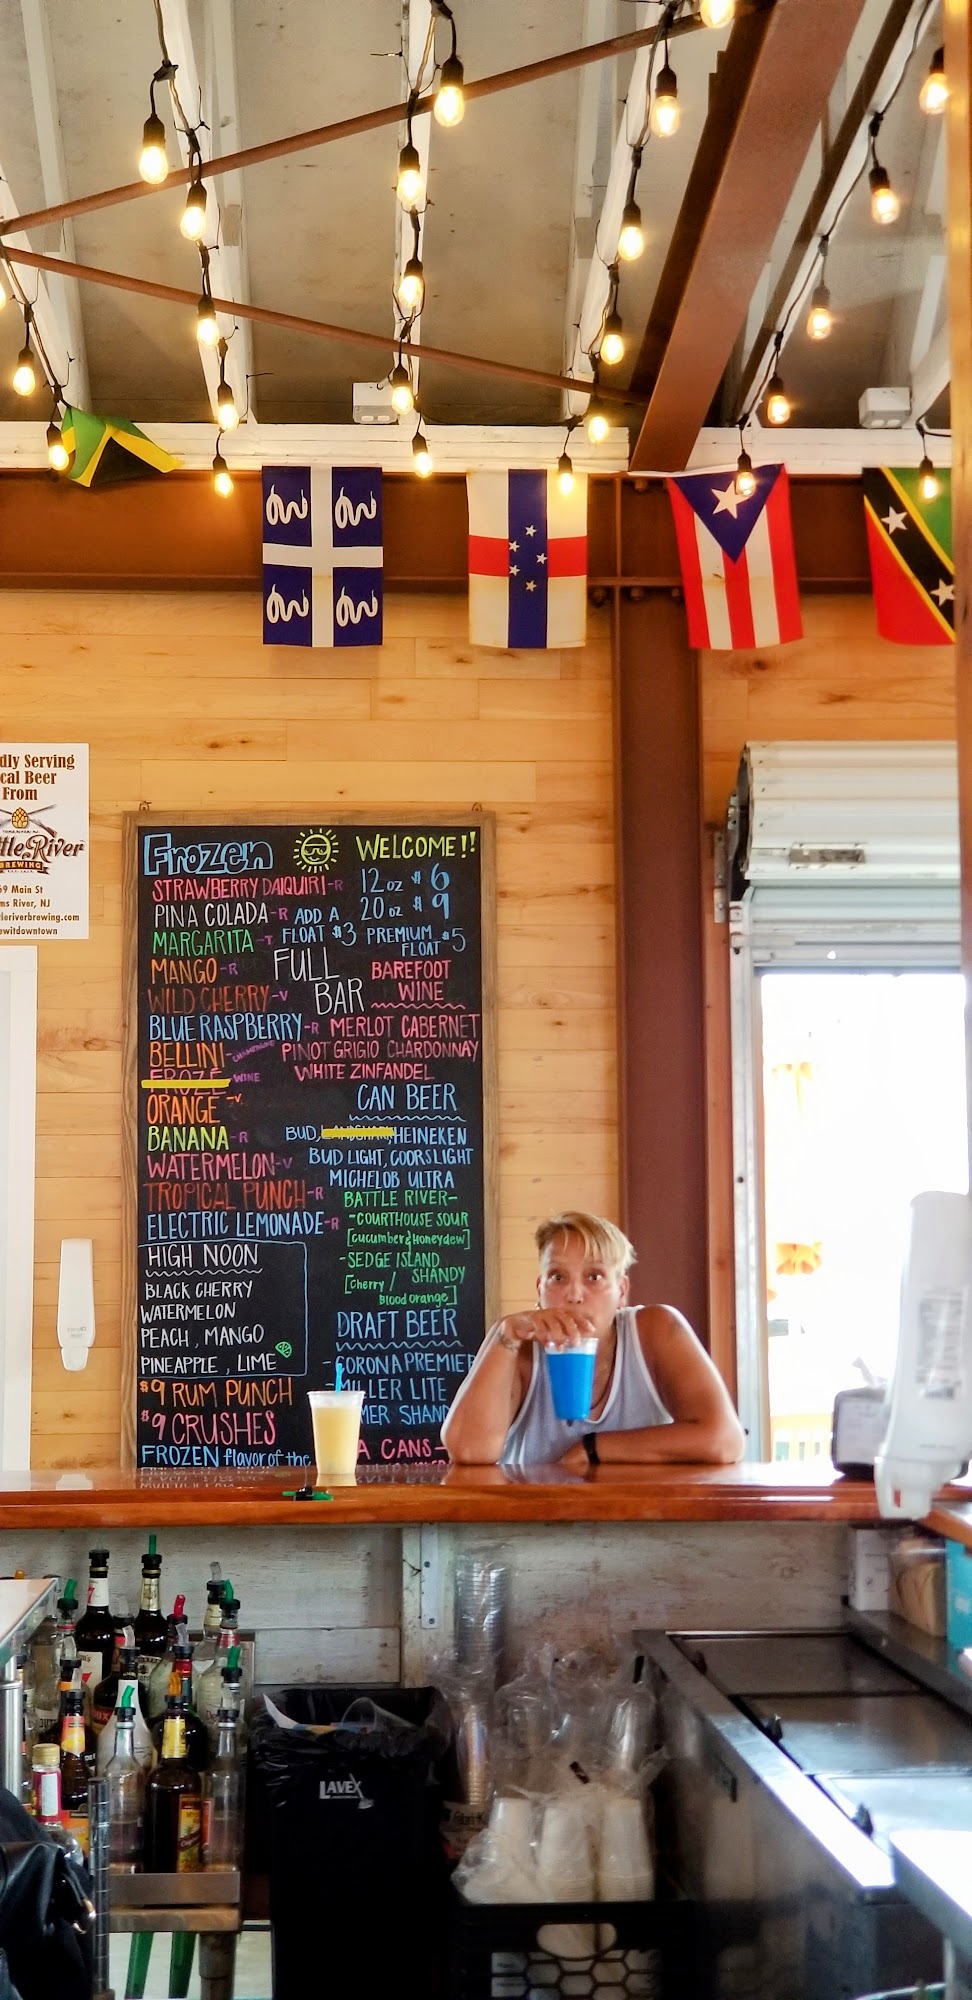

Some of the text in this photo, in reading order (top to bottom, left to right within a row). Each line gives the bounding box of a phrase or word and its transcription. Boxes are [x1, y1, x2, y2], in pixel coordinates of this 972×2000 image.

[24, 754, 75, 770] Serving
[24, 771, 57, 784] Beer
[2, 787, 38, 800] From
[22, 834, 85, 863] River
[144, 833, 273, 875] Frozen
[11, 885, 32, 894] Main
[35, 885, 43, 894] St
[153, 877, 259, 901] STRAWBERRY
[361, 867, 384, 893] 12
[387, 880, 404, 892] oz
[13, 899, 37, 909] River,
[40, 899, 51, 908] NJ
[360, 897, 384, 920] 20
[389, 907, 403, 917] oz
[0, 912, 80, 923] leriverbrewing.com
[155, 904, 198, 928] PINA
[294, 907, 339, 924] ADD A
[282, 925, 325, 944] FLOAT
[367, 925, 432, 944] PREMIUM
[402, 941, 441, 957] FLOAT
[274, 947, 339, 981] FULL
[371, 960, 451, 980] BAREFOOT
[148, 988, 195, 1014] WILD
[315, 978, 364, 1015] BAR
[398, 982, 444, 1001] WINE
[149, 1015, 196, 1041] BLUE
[330, 1014, 480, 1038] MERLOT CABERNET
[282, 1040, 479, 1062] PINOT GRIGIO CHARDONNAY
[294, 1062, 435, 1082] WHITE ZINFANDEL
[357, 1083, 457, 1111] CAN BEER
[147, 1094, 220, 1125] ORANGE
[309, 1147, 343, 1166] BUD
[329, 1170, 455, 1189] MICHELOB ULTRA
[143, 1181, 236, 1211] TROPICAL
[344, 1190, 398, 1208] BATTLE
[147, 1211, 229, 1240] ELECTRIC
[436, 1212, 469, 1227] SOUR
[148, 1243, 259, 1268] HIGH NOON
[395, 1252, 440, 1268] ISLAND
[412, 1266, 466, 1284] SHANDY
[145, 1280, 253, 1300] BLACK CHERRY
[140, 1302, 236, 1324] WATERMELON
[337, 1309, 457, 1339] DRAFT BEER
[205, 1324, 264, 1346] MANGO
[237, 1353, 277, 1372] LIME
[172, 1382, 218, 1408] RUM
[225, 1376, 293, 1406] PUNCH
[410, 1377, 446, 1401] LITE
[171, 1410, 277, 1445] CRUSHES
[142, 1445, 219, 1467] FROZEN
[285, 1451, 312, 1467] the
[320, 1777, 363, 1799] LAVEX
